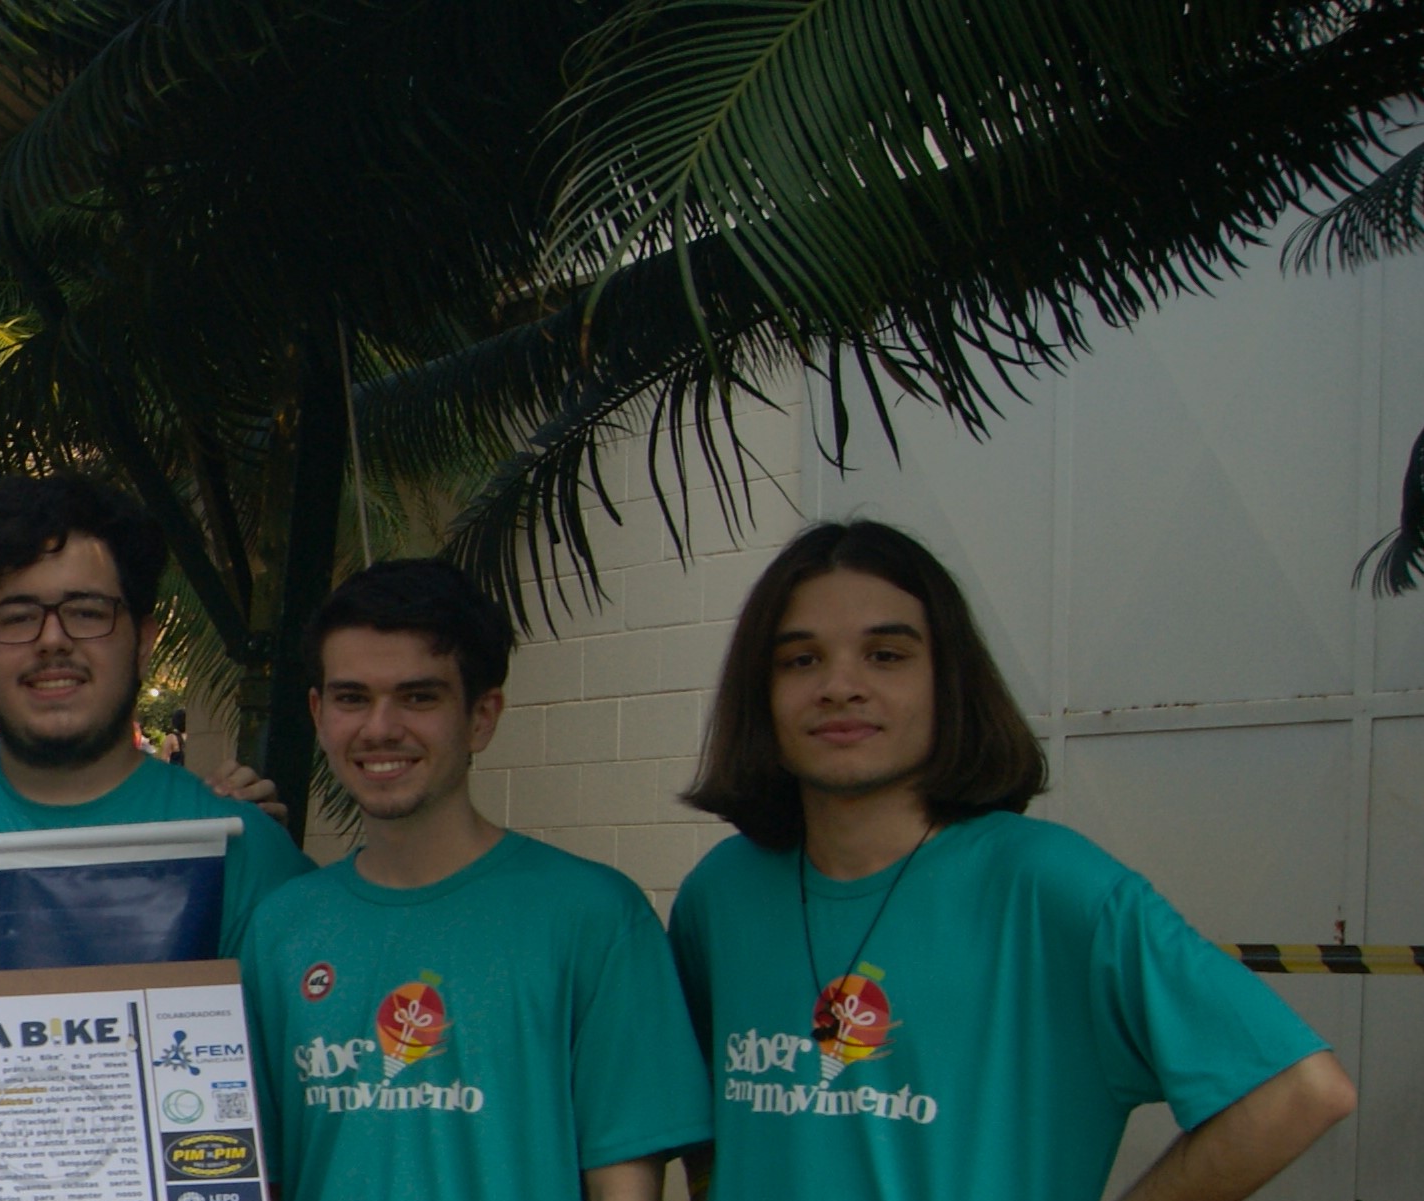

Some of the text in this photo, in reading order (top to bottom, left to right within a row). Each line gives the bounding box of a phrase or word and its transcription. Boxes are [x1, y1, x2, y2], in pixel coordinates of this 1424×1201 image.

[156, 1010, 232, 1020] COLABORADORES
[195, 1044, 244, 1057] FEM
[725, 1028, 813, 1075] Saber
[173, 1147, 247, 1162] PIM PIM
